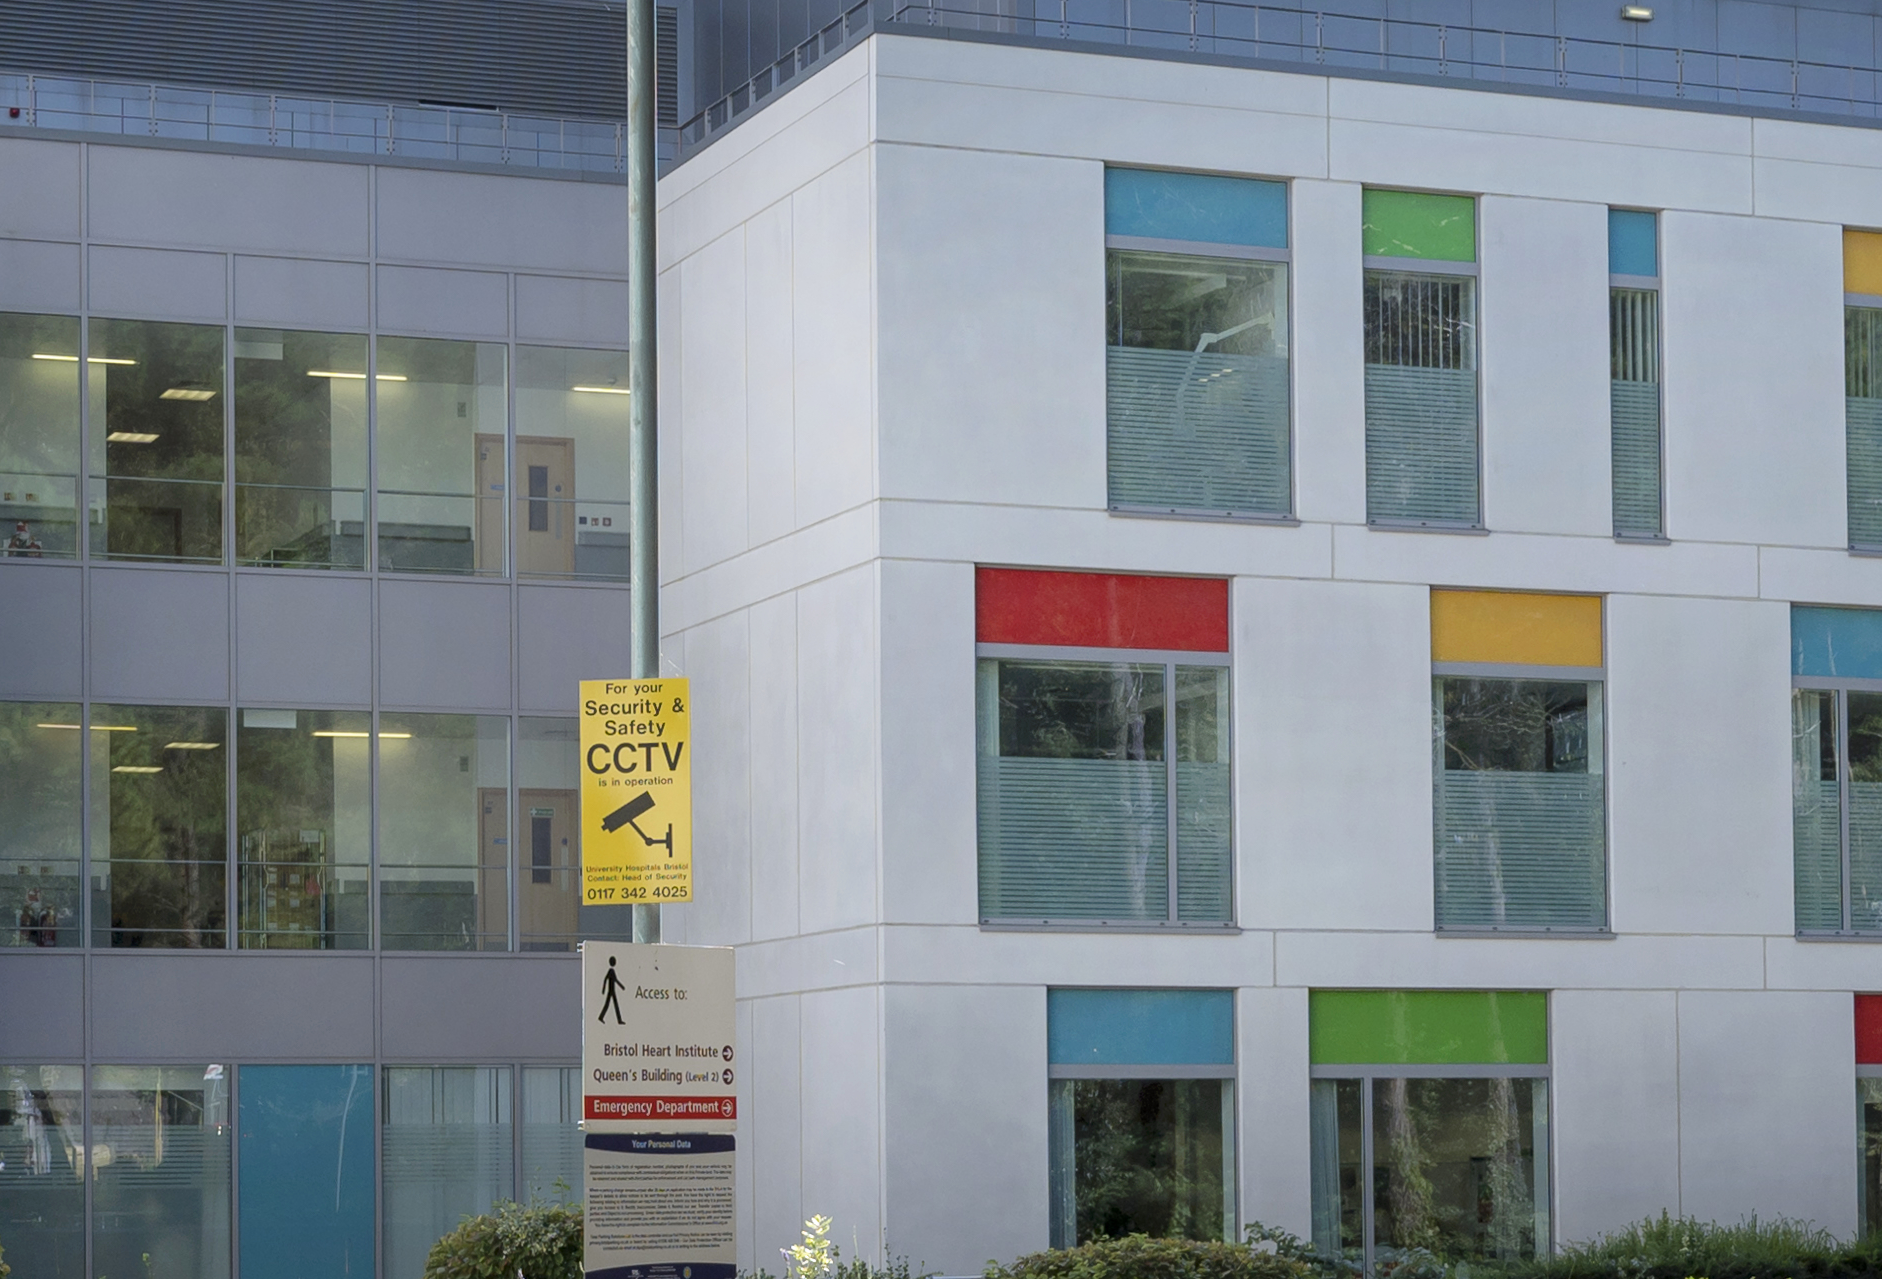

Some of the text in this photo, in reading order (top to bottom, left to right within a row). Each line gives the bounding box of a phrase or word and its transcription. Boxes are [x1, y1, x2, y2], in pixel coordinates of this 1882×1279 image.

[606, 683, 663, 695] For your
[585, 697, 684, 716] Security &
[605, 720, 665, 737] Safety
[586, 742, 684, 774] CCTV
[598, 776, 673, 787] is in operation
[586, 863, 688, 873] University Hospitals Bristol
[656, 873, 687, 881] Security
[587, 886, 687, 900] 0117 342 4025
[635, 985, 687, 1000] Access to:
[604, 1043, 718, 1058] Bristol Heart Institute
[593, 1068, 719, 1085] Queen's Building (Level 2)
[593, 1100, 719, 1116] Emergency Department
[632, 1140, 691, 1148] Your Personal Data
